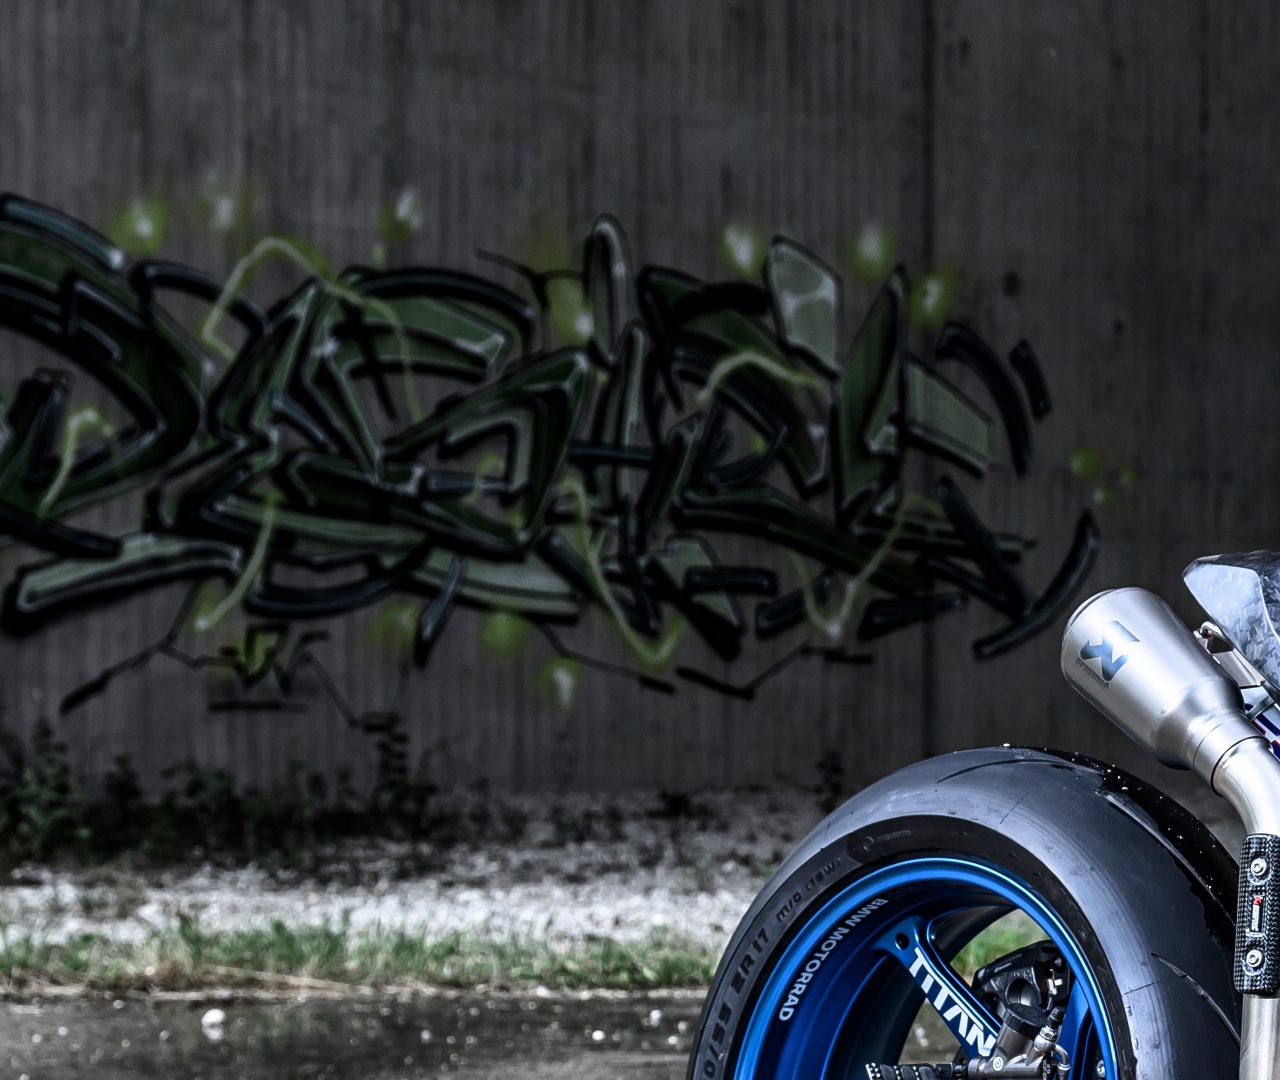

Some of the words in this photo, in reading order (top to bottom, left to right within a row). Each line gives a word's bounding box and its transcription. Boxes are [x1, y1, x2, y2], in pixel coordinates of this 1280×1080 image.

[752, 926, 769, 954] 17
[848, 897, 889, 929] BMW
[778, 924, 850, 1022] MOTORRAD
[909, 946, 997, 1057] TITAN
